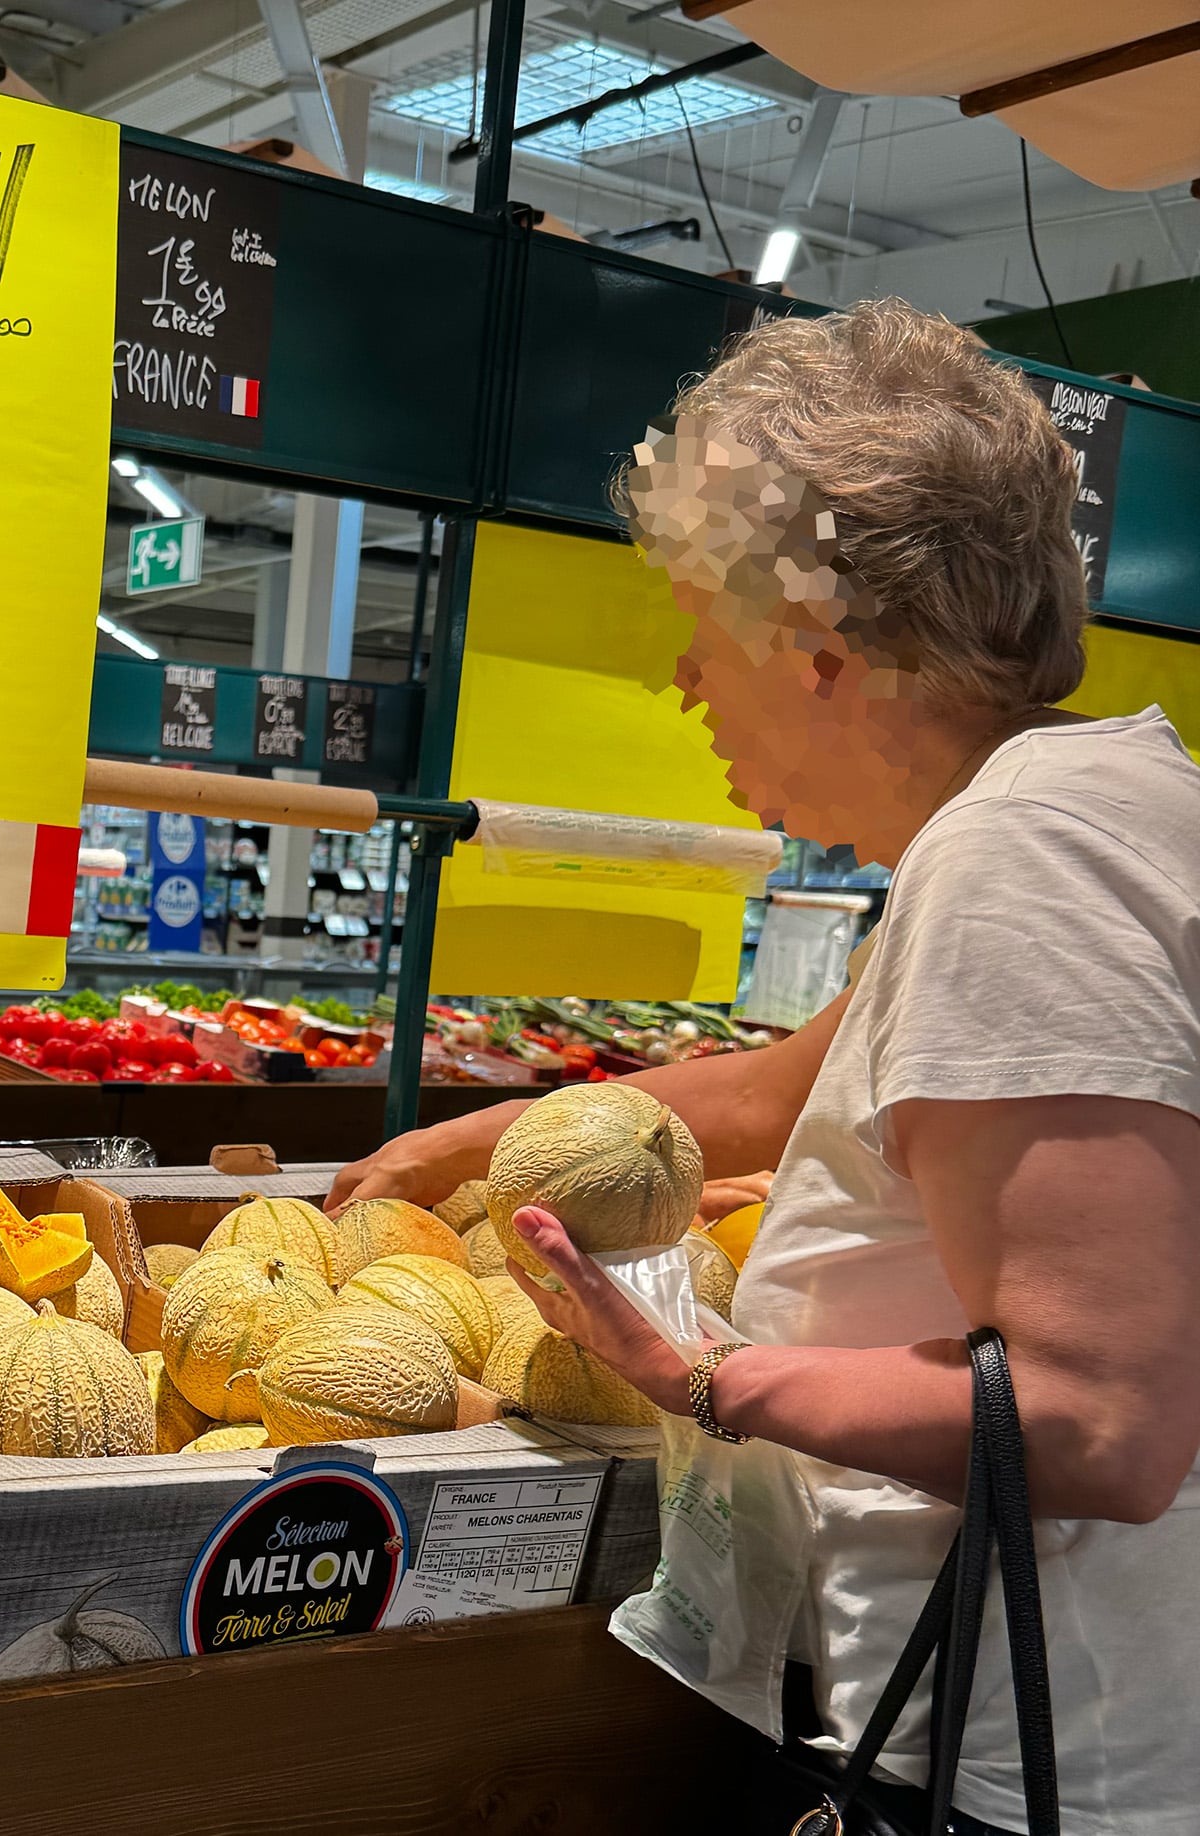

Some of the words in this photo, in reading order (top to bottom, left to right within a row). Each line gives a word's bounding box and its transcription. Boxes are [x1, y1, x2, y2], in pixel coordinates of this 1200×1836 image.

[128, 173, 217, 223] MELON
[112, 340, 217, 410] FRANCE
[451, 1492, 497, 1505] FRANCE
[467, 1514, 514, 1528] MELONS
[516, 1509, 584, 1525] CHARENTAIS
[266, 1515, 349, 1551] Sélection
[223, 1549, 375, 1597] MELON
[212, 1608, 271, 1647] Terre
[272, 1604, 296, 1635] &
[295, 1592, 352, 1630] Soleil
